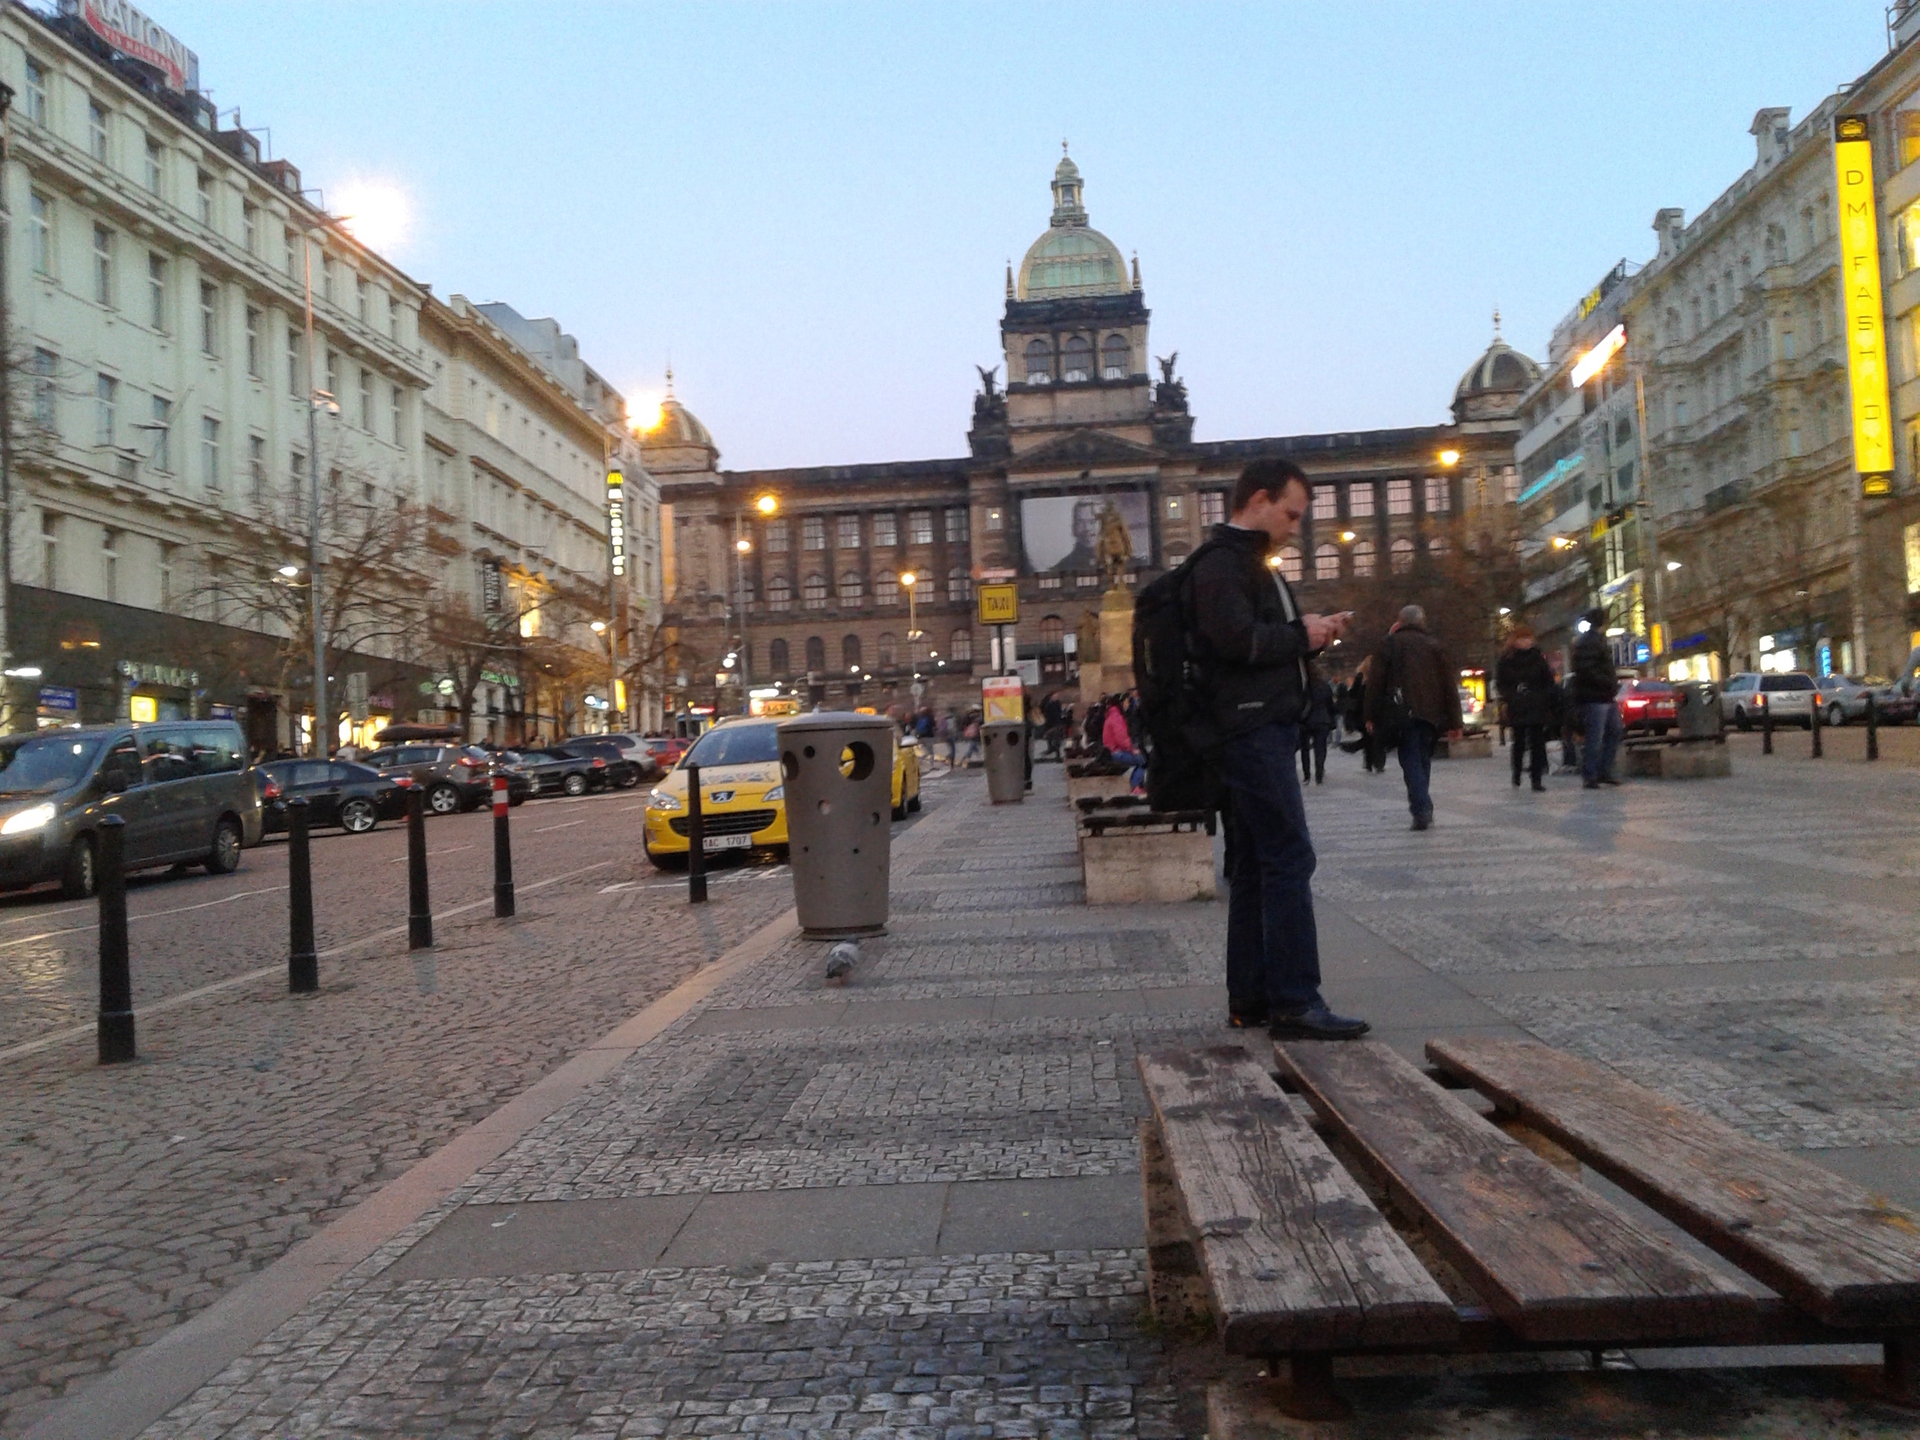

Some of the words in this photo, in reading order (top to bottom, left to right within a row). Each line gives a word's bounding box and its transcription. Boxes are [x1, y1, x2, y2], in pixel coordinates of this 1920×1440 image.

[1846, 169, 1868, 217] DM
[1853, 255, 1882, 450] FASHO
[987, 596, 1010, 611] TAXI
[726, 835, 748, 846] 1707
